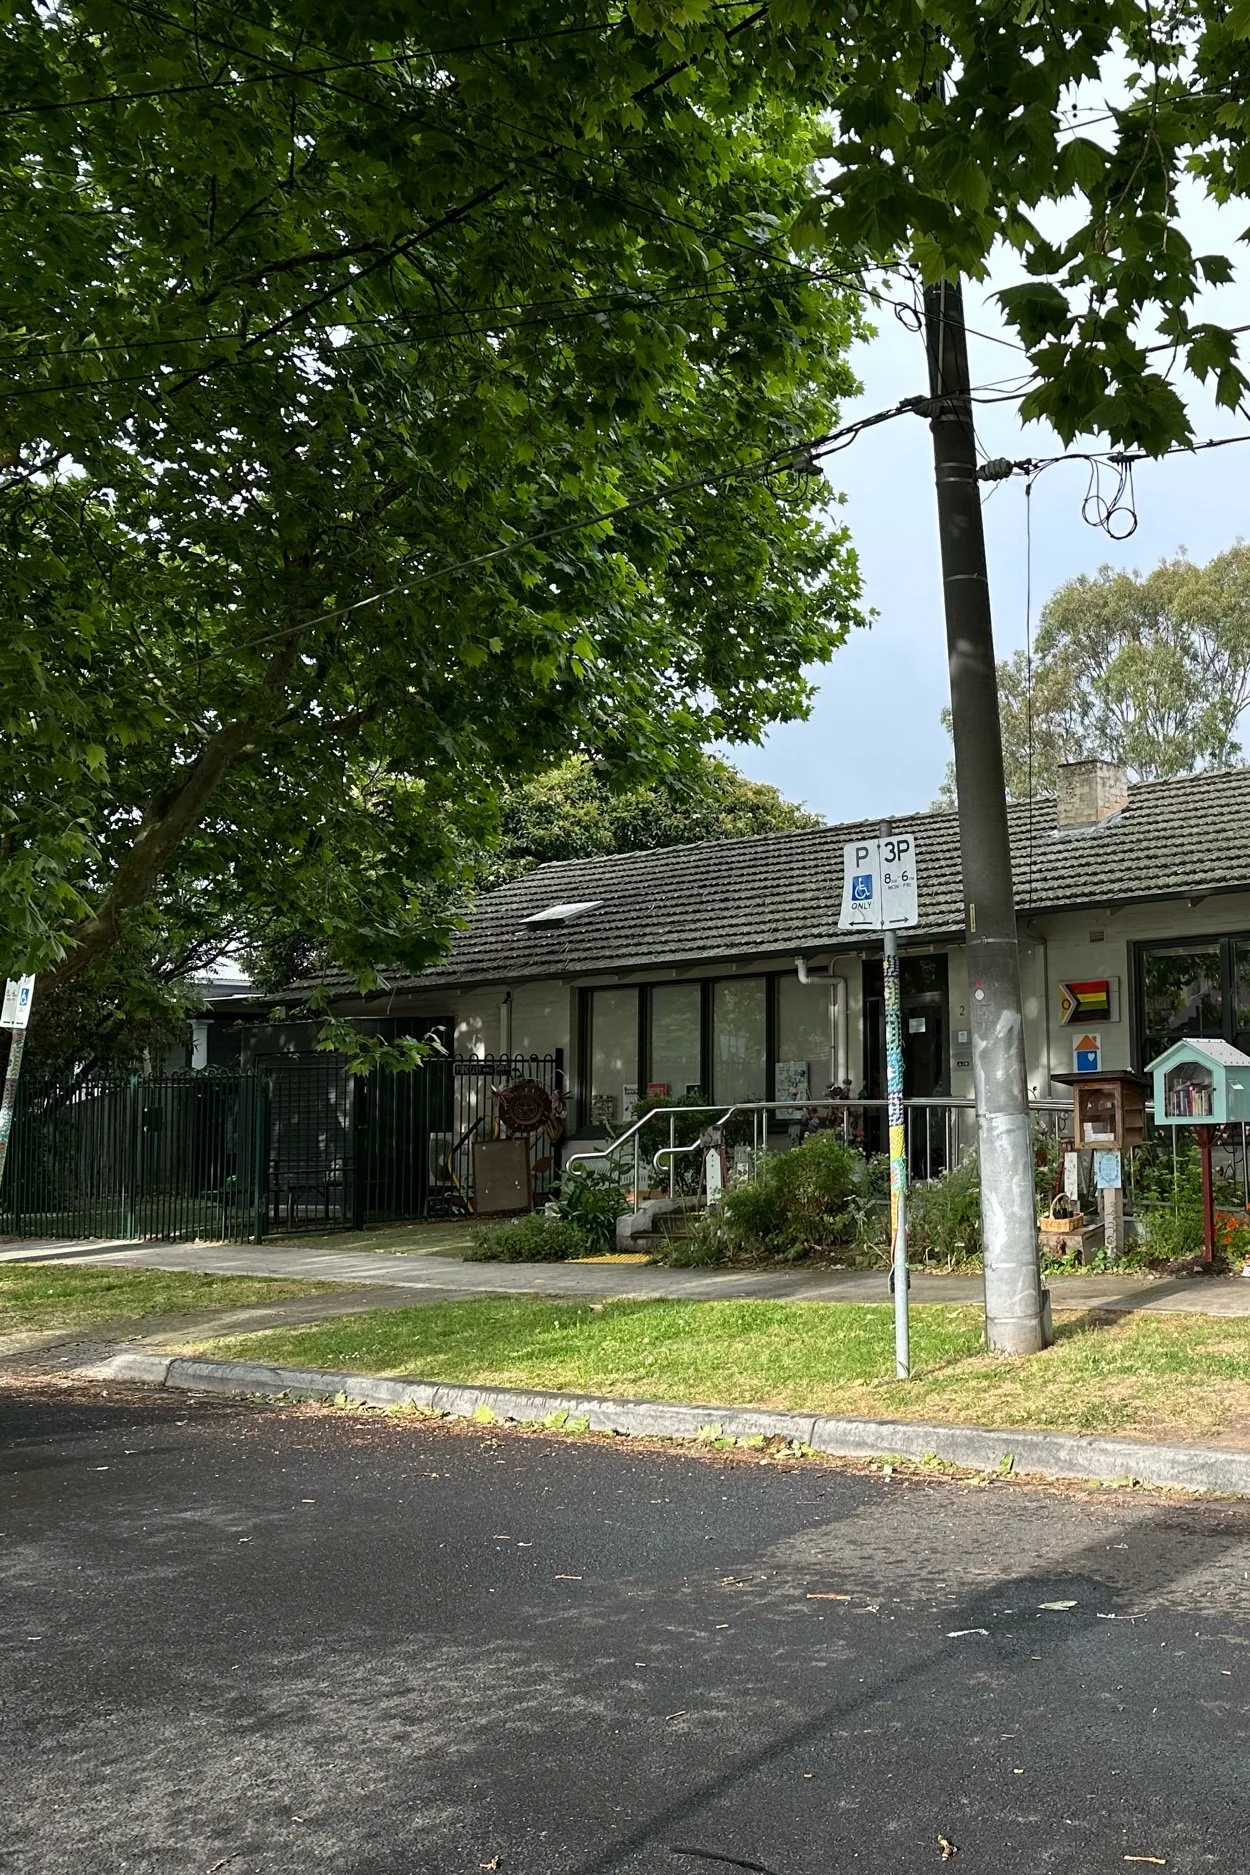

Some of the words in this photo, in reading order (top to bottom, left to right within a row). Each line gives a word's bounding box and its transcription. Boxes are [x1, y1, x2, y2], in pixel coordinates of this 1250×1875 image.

[855, 846, 869, 868] P
[884, 840, 910, 862] 3P
[851, 901, 872, 910] ONLY
[959, 1005, 965, 1016] 2
